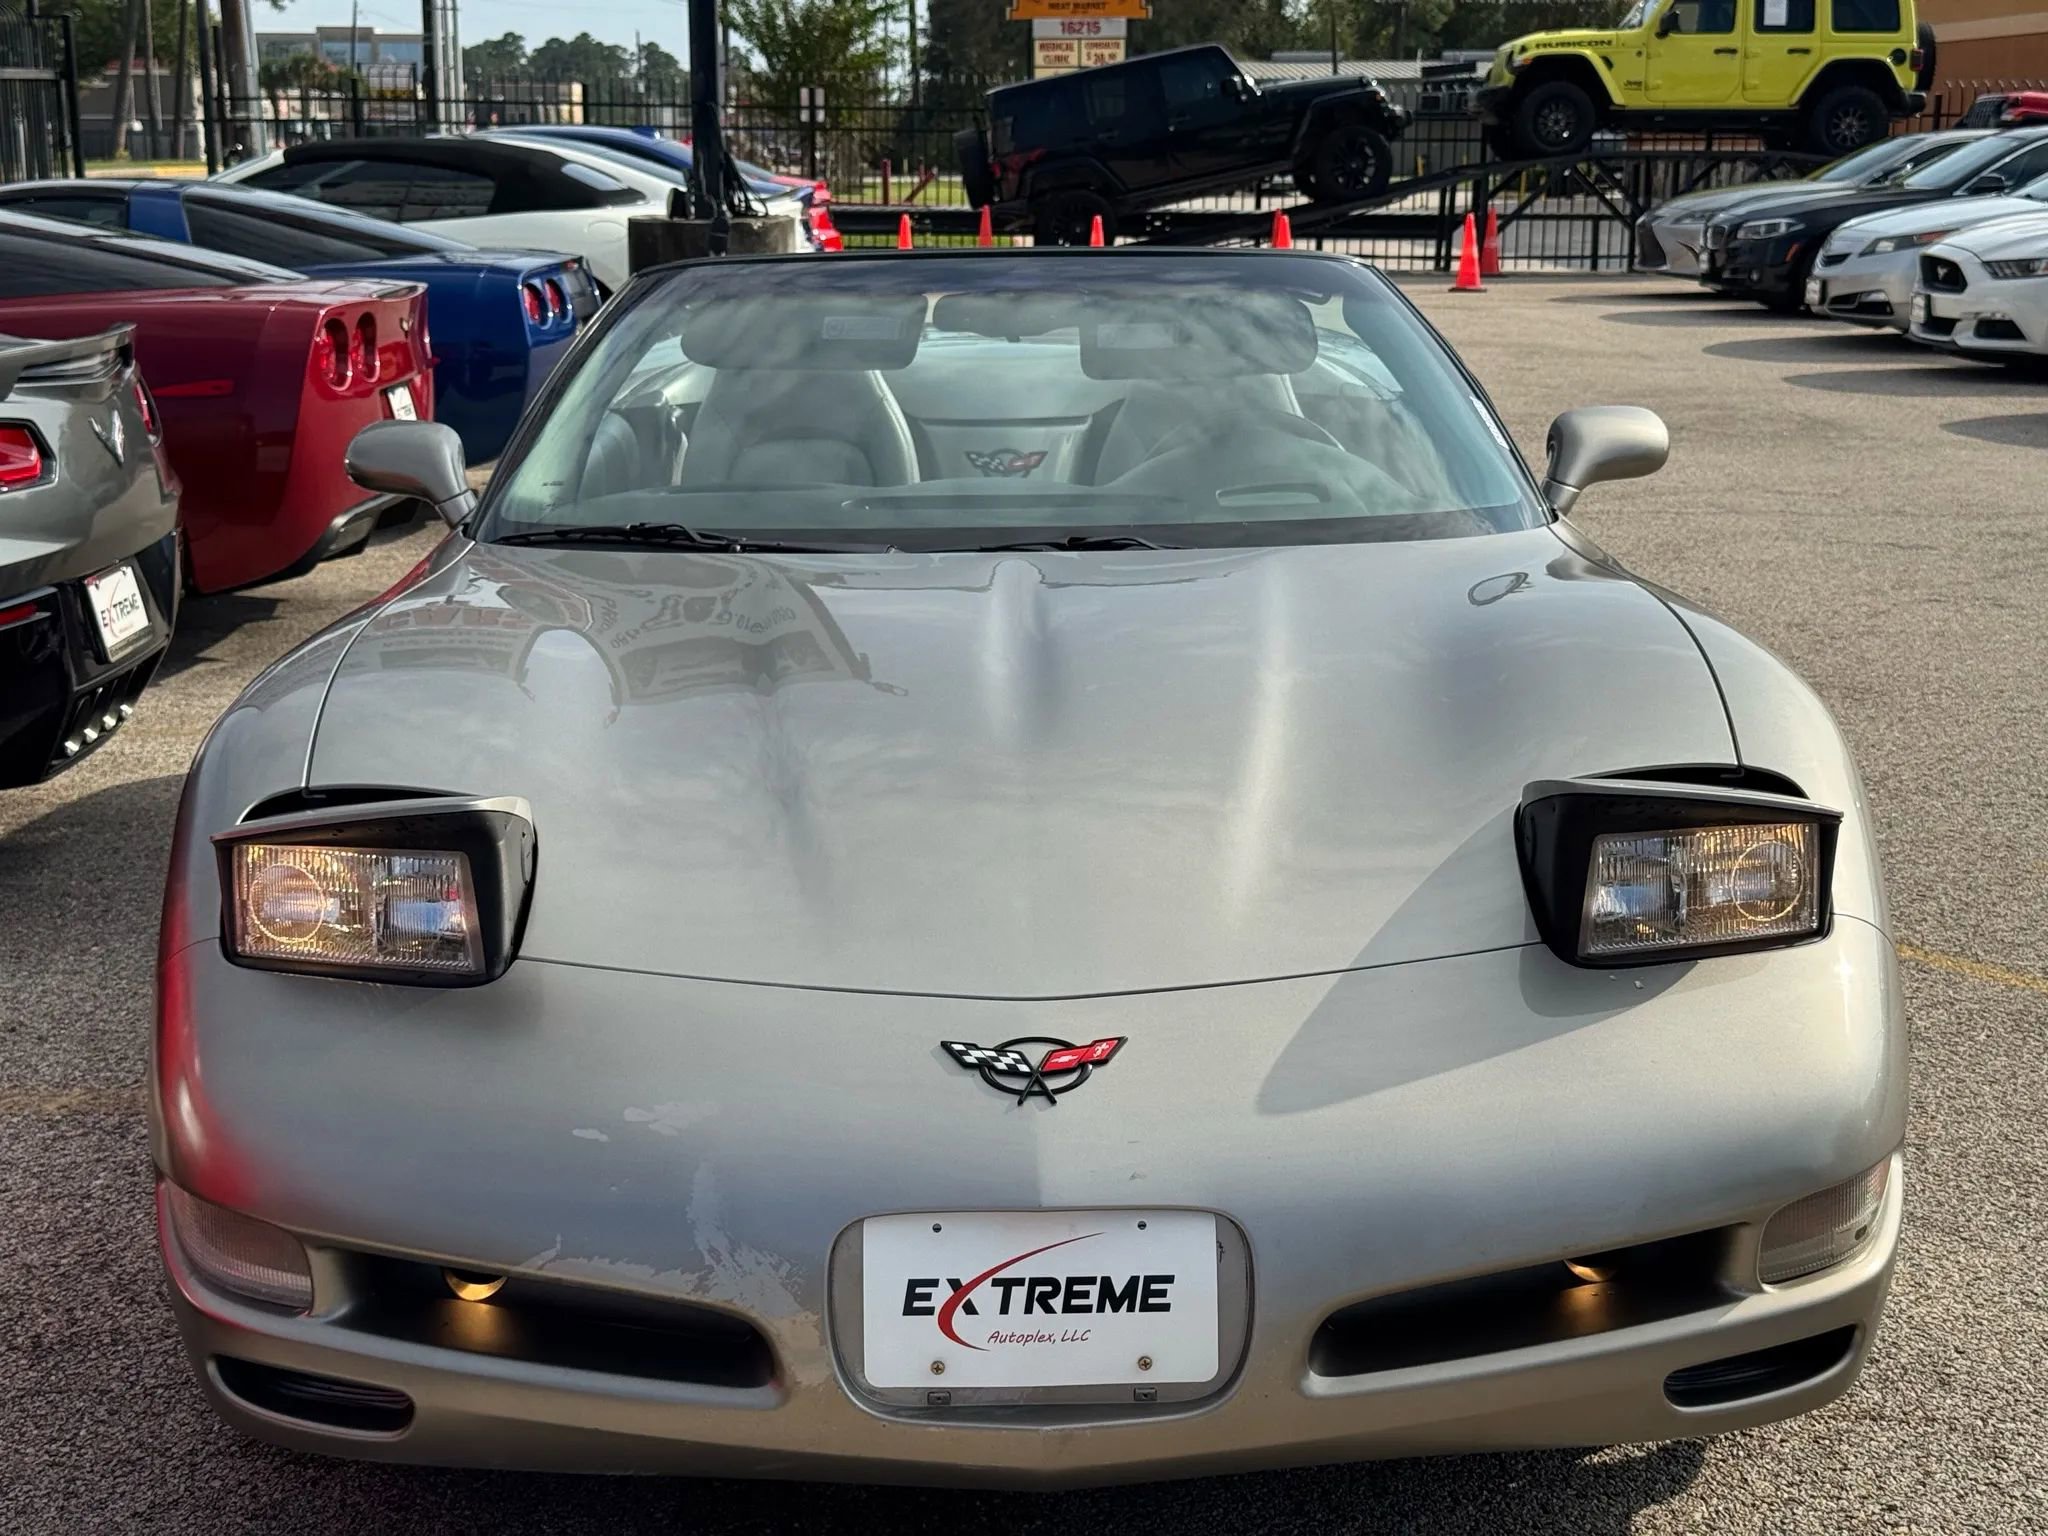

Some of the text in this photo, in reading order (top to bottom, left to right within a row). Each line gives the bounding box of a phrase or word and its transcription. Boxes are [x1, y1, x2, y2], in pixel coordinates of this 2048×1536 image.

[1060, 20, 1101, 35] 16215
[1039, 42, 1074, 52] MEDICAL
[1535, 40, 1612, 49] RUBICON
[1042, 54, 1070, 64] CLINIC
[101, 593, 140, 628] EXTREME
[902, 1274, 1175, 1316] EXTREME
[987, 1329, 1092, 1347] Autoplex, LLC
